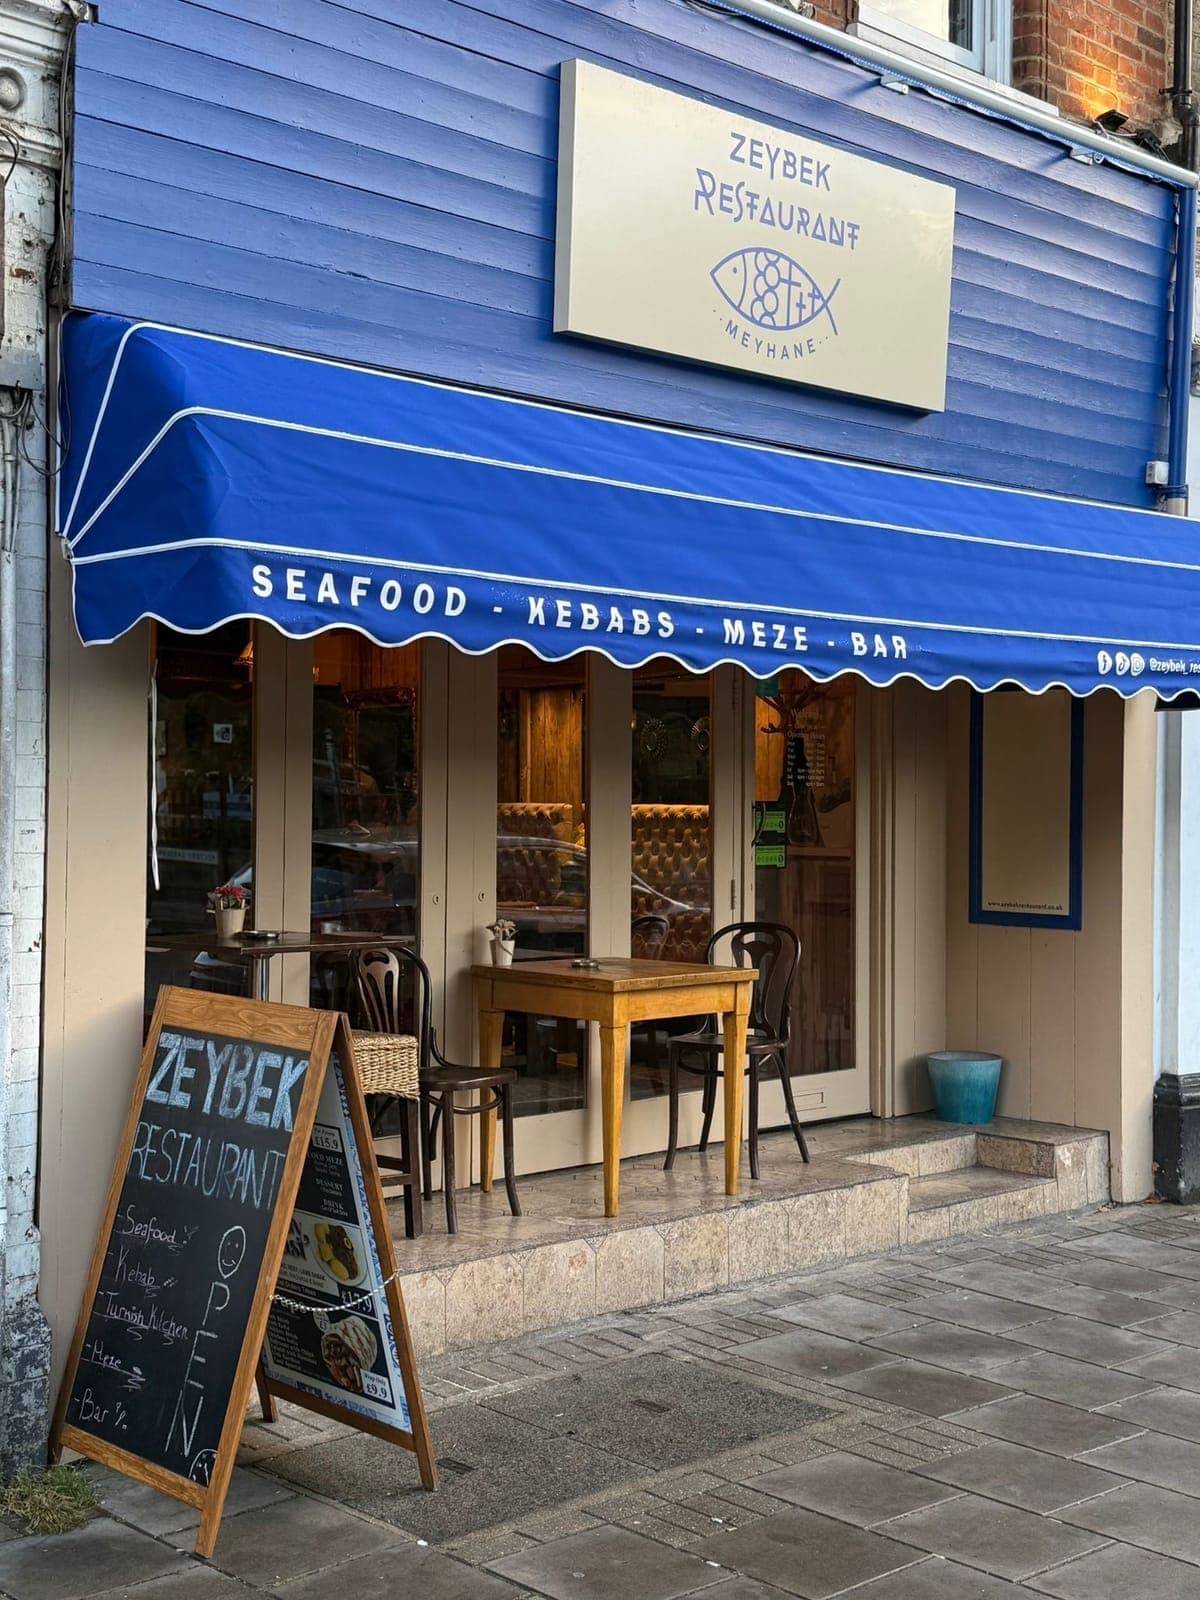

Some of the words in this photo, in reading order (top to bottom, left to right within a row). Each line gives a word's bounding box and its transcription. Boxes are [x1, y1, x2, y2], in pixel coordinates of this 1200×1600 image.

[729, 131, 832, 191] ZEYBEK
[694, 168, 860, 250] RESTAURANT
[725, 319, 816, 361] MEYHANE
[252, 564, 466, 617] SEAFOOD
[528, 596, 675, 639] KEBABS
[723, 618, 809, 651] MEZE
[851, 631, 908, 660] BAR
[146, 1032, 309, 1132] ZEYBEK
[128, 1121, 286, 1210] RESTAURANT
[122, 1204, 177, 1245] Seafood
[115, 1245, 156, 1287] Kebab
[79, 1388, 109, 1421] Bar
